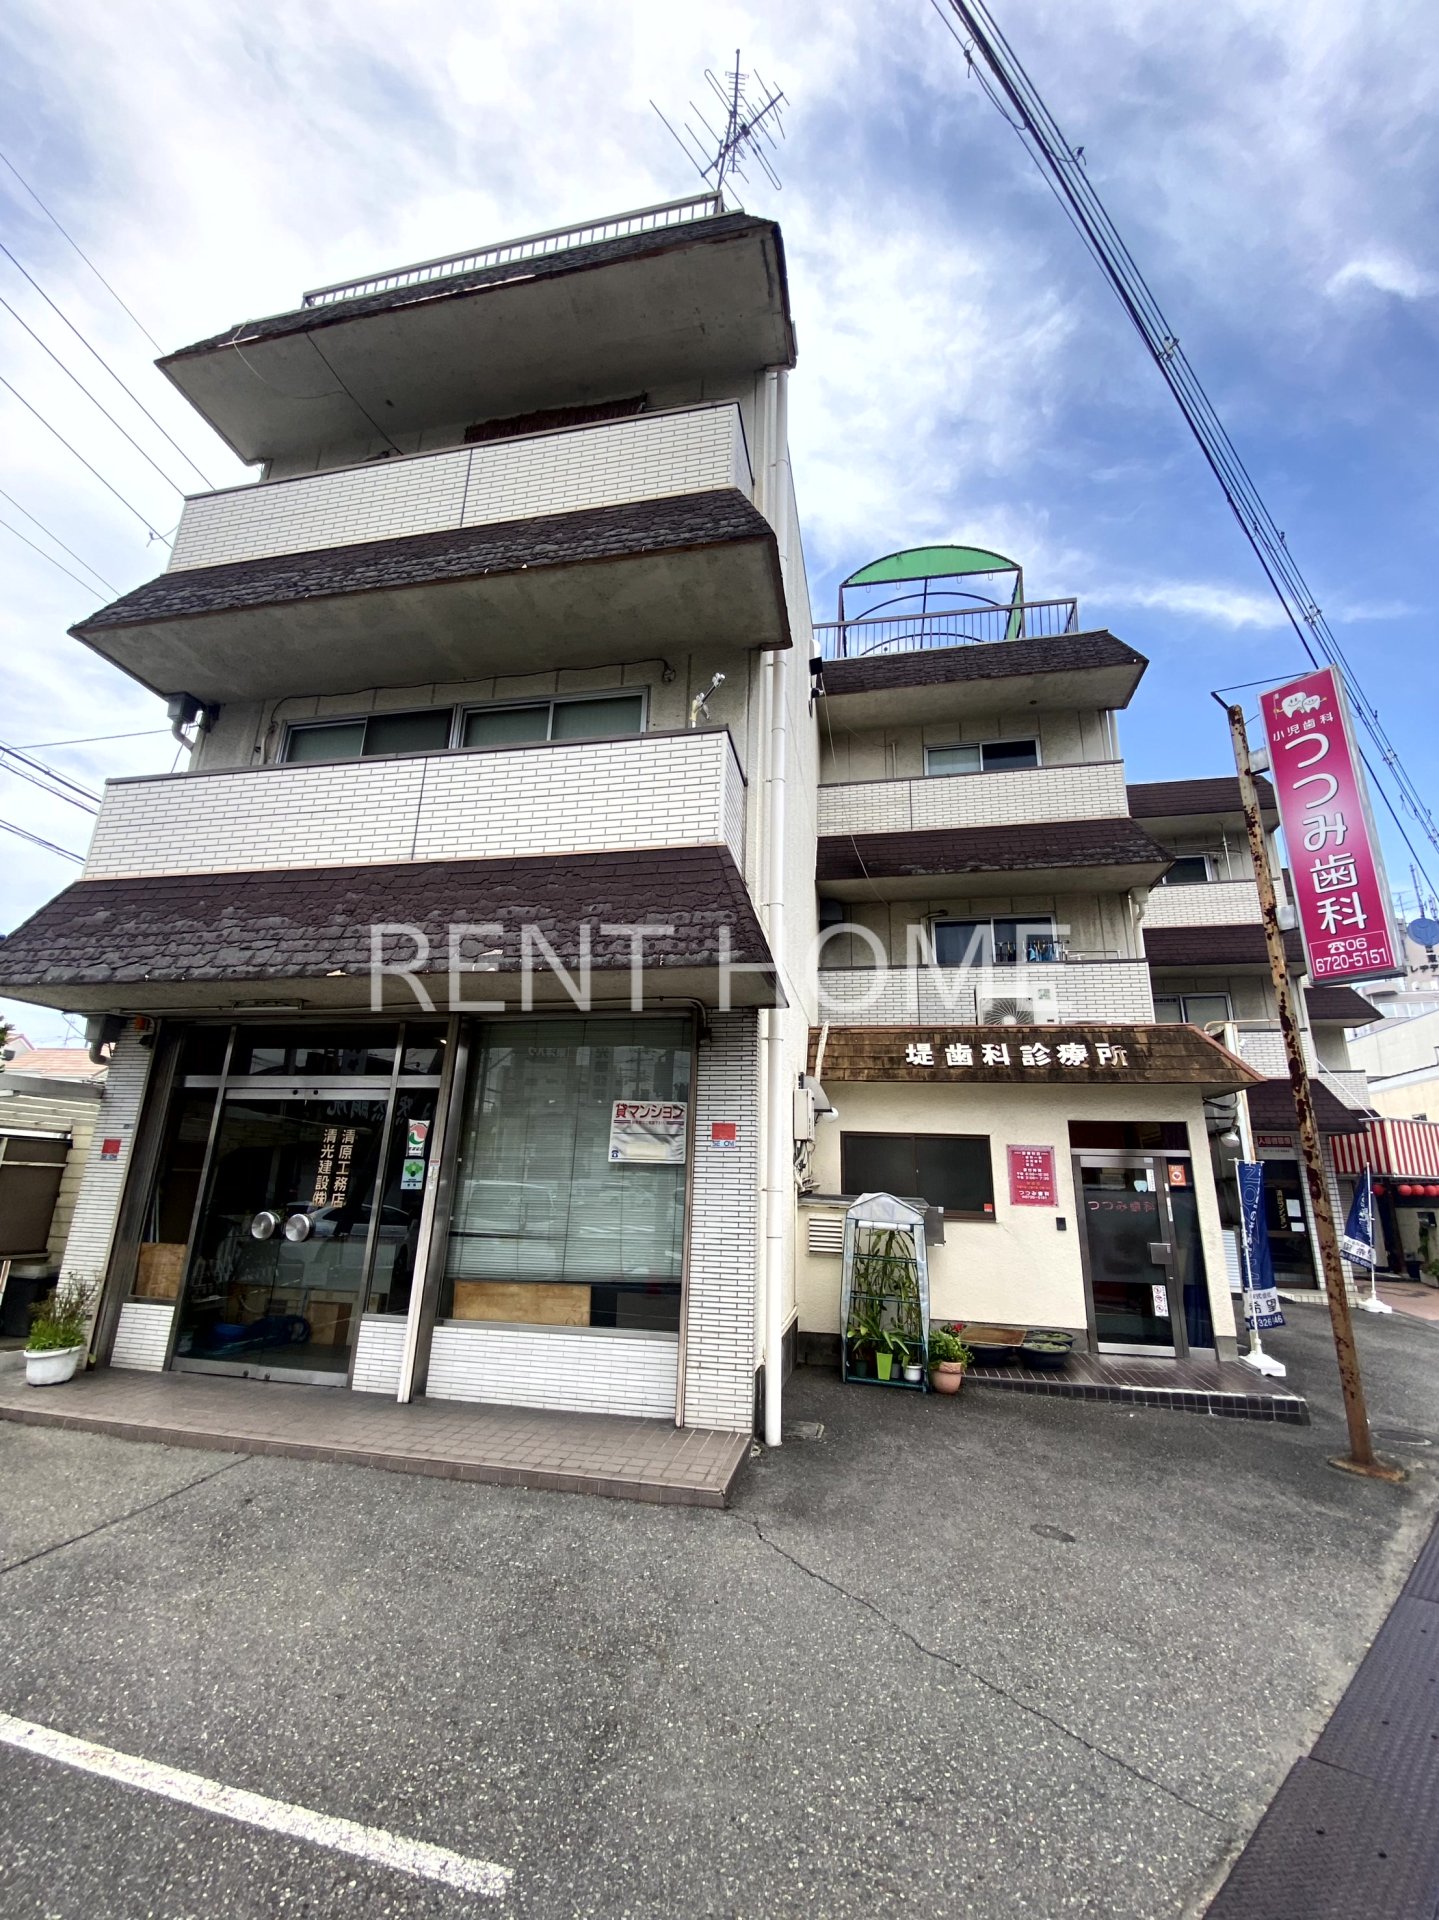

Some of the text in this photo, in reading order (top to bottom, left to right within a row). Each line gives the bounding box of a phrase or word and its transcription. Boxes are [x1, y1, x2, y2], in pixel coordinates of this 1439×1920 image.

[1272, 711, 1334, 742] 小児歯科
[1284, 732, 1368, 935] つつみ歯科
[1315, 947, 1388, 973] 6720-5151
[905, 1042, 1129, 1067] 堤歯科診療所
[615, 1102, 685, 1120] 貸マンション
[331, 1129, 356, 1208] 清原工務店
